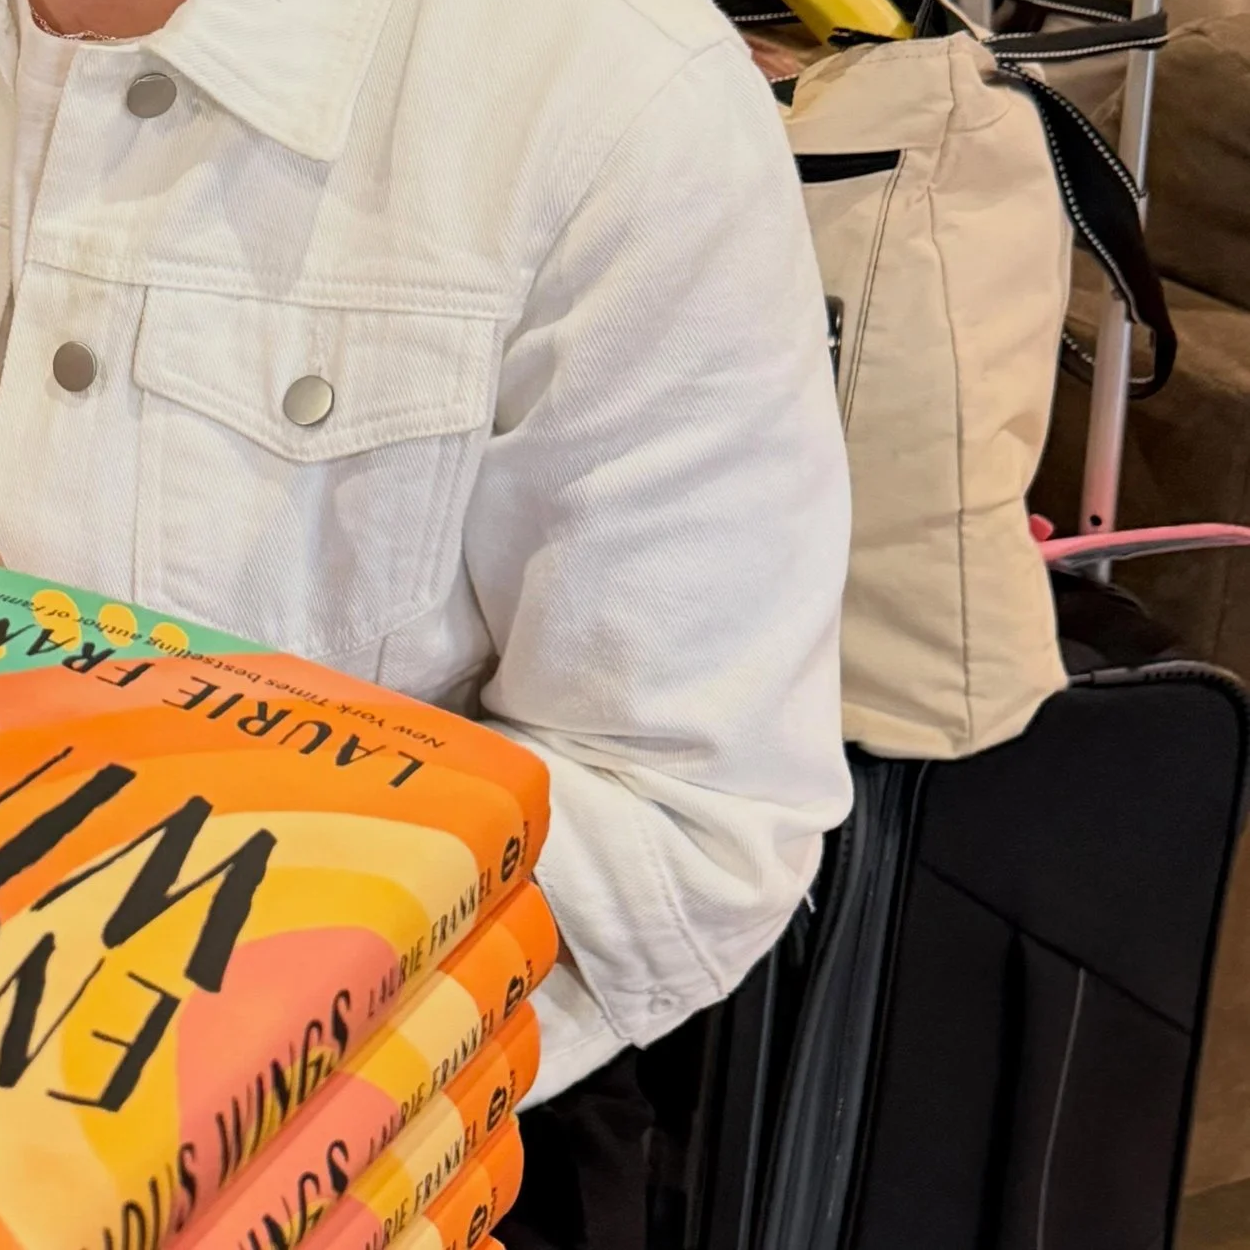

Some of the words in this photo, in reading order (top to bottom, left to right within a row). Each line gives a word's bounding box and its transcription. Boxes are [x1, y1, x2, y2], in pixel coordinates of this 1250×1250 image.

[47, 606, 71, 619] of
[73, 612, 143, 640] author
[144, 634, 262, 685] bestselling
[264, 678, 330, 708] Times
[161, 675, 425, 788] LAURIE
[336, 702, 385, 729] York
[393, 724, 446, 749] New
[215, 990, 351, 1189] WINGS
[367, 936, 425, 1019] LAURIE
[429, 867, 492, 956] FRANKEL
[430, 1008, 494, 1094] FRANKEL
[414, 1120, 477, 1215] FRANKEL
